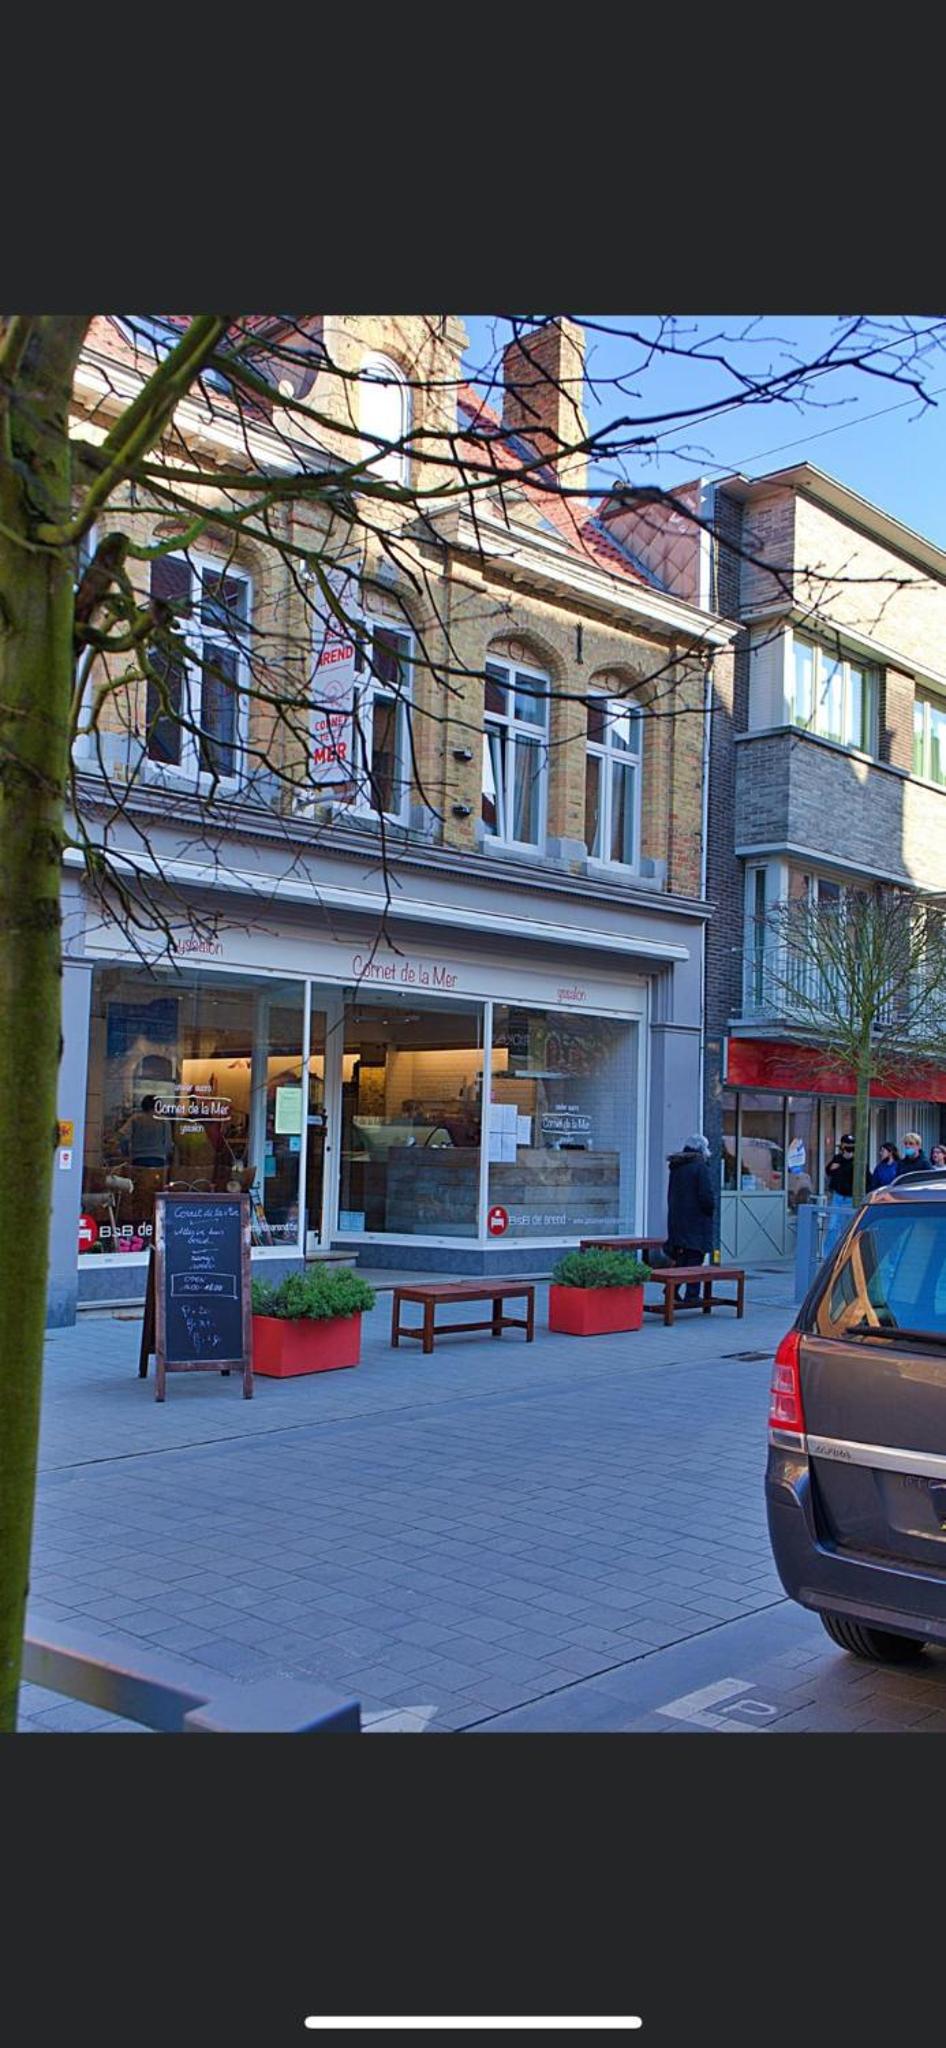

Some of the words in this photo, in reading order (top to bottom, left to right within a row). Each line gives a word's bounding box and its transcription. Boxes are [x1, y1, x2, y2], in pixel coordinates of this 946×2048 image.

[314, 742, 347, 765] MER
[352, 954, 396, 980] Cornet
[401, 962, 415, 982] de
[419, 964, 429, 985] la
[433, 966, 457, 988] Mer
[154, 1100, 186, 1114] Cornet
[188, 1101, 200, 1114] de
[201, 1101, 210, 1115] la
[211, 1101, 230, 1115] Mer
[138, 1221, 153, 1236] de
